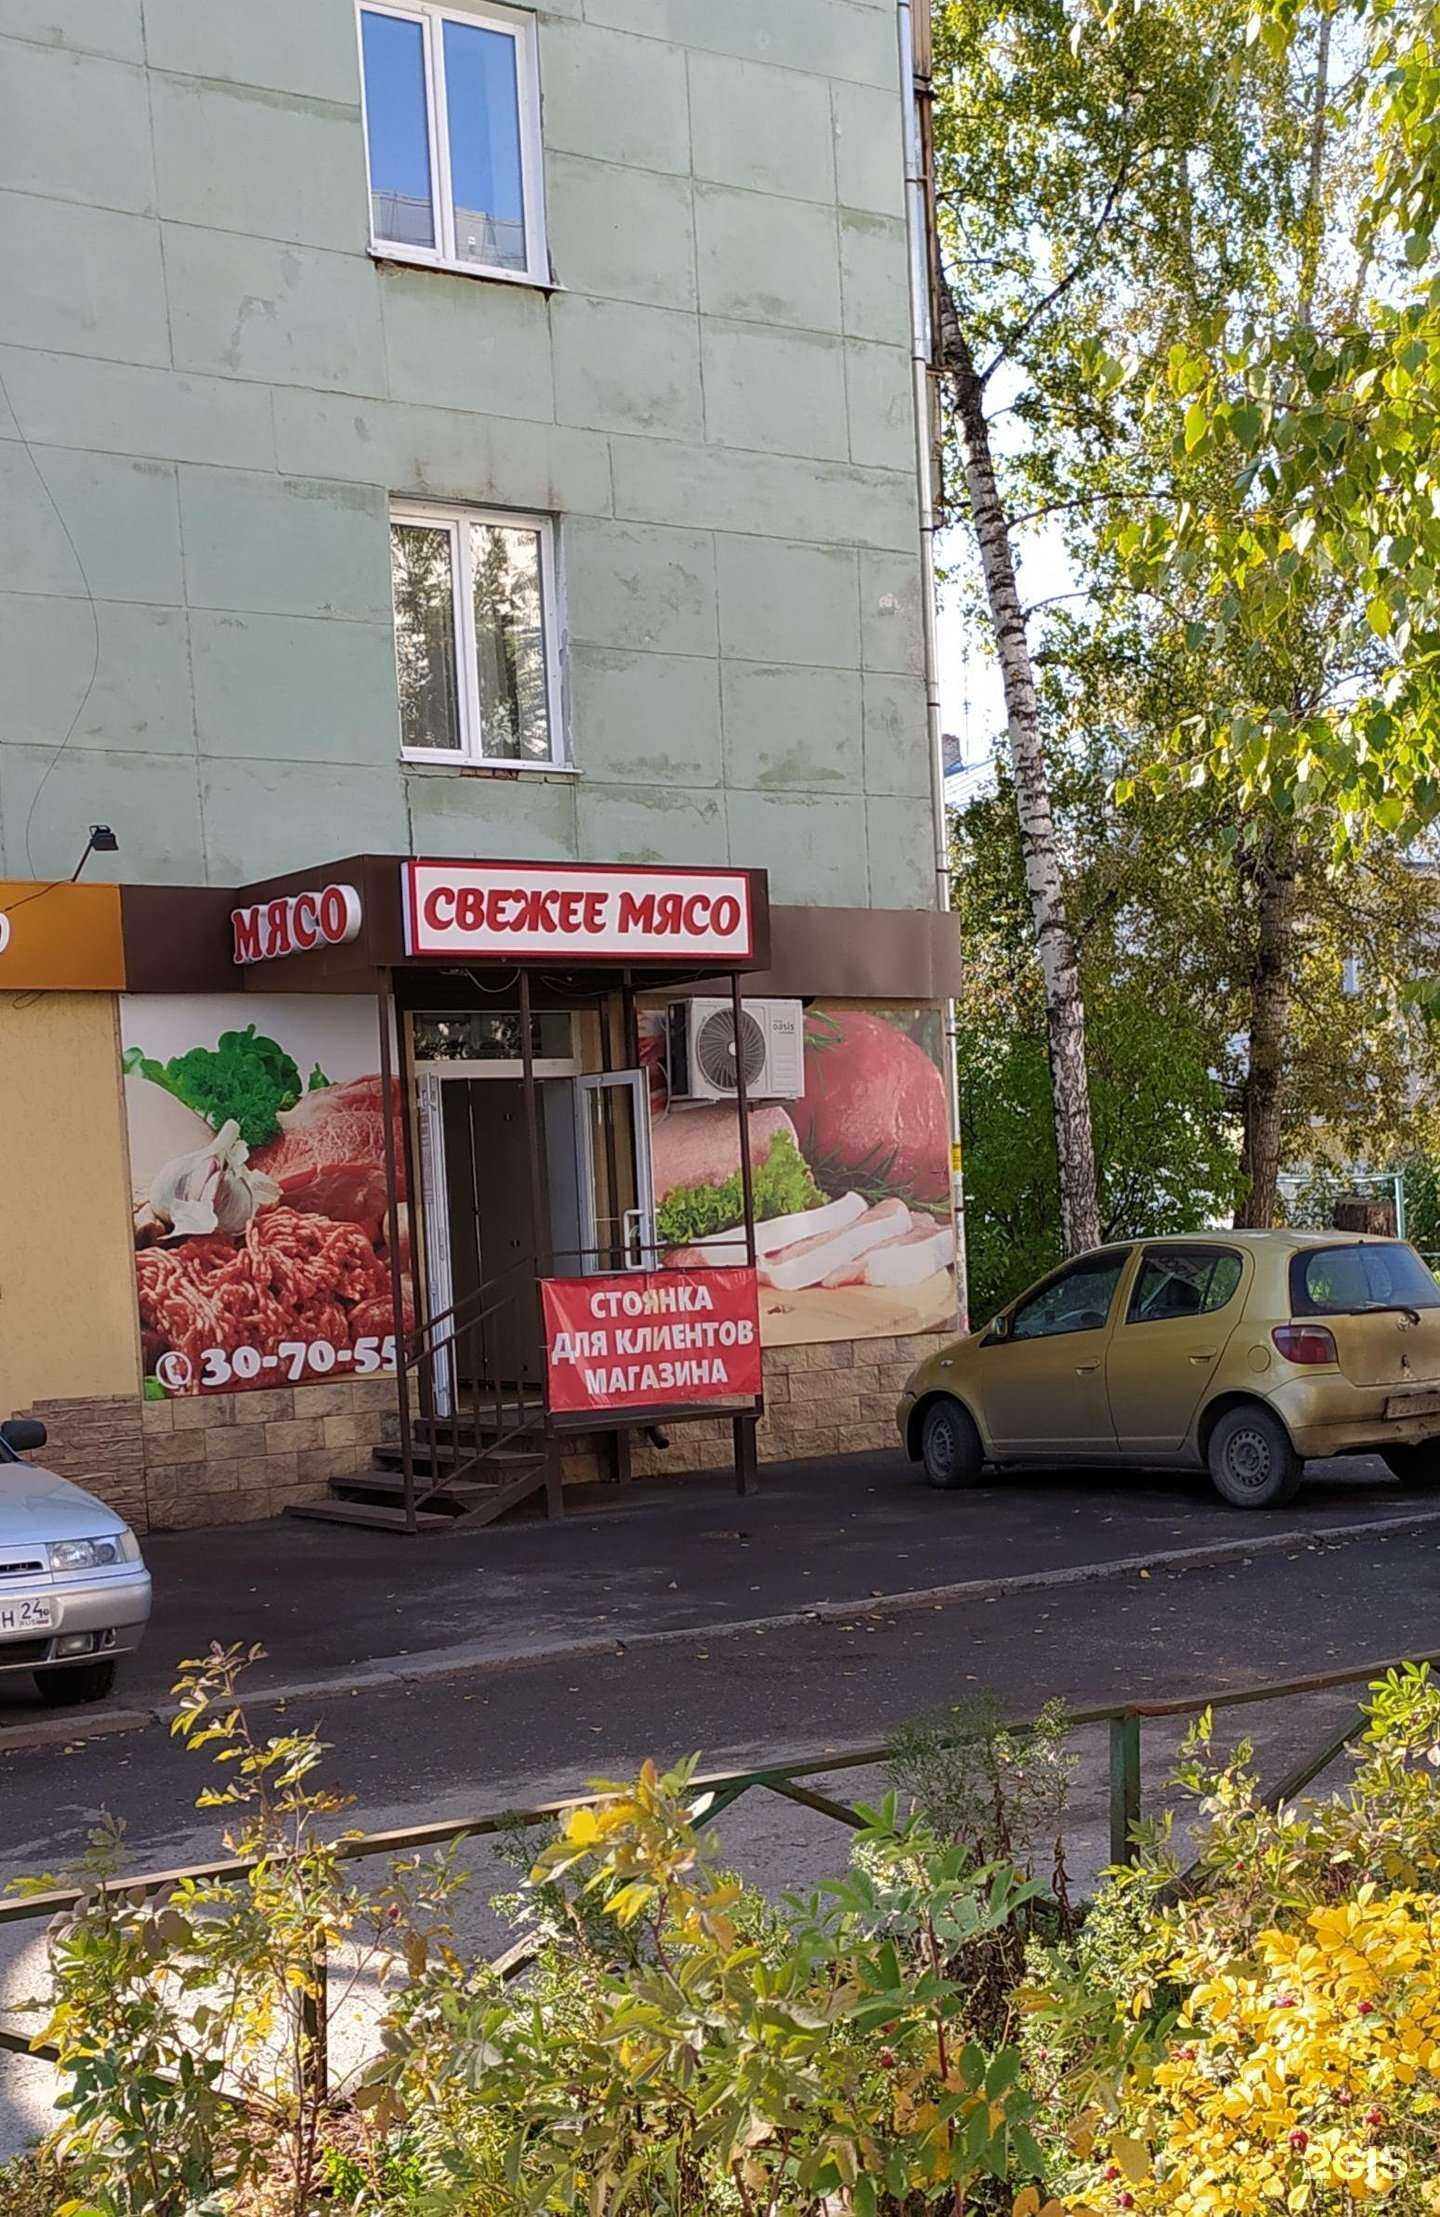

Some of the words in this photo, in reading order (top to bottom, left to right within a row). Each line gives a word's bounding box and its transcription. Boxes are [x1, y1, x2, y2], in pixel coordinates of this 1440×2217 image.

[231, 884, 348, 965] МЯСО
[423, 886, 609, 933] СВЕЖЕЕ
[617, 891, 742, 937] МЯСО
[590, 1285, 714, 1319] СТОЯНКА
[201, 1335, 399, 1386] 30-70-55
[551, 1330, 609, 1366] ДЛЯ
[615, 1319, 754, 1355] КЛИЕНТОВ
[584, 1358, 729, 1395] МАГАЗИНА
[21, 1599, 42, 1619] 24
